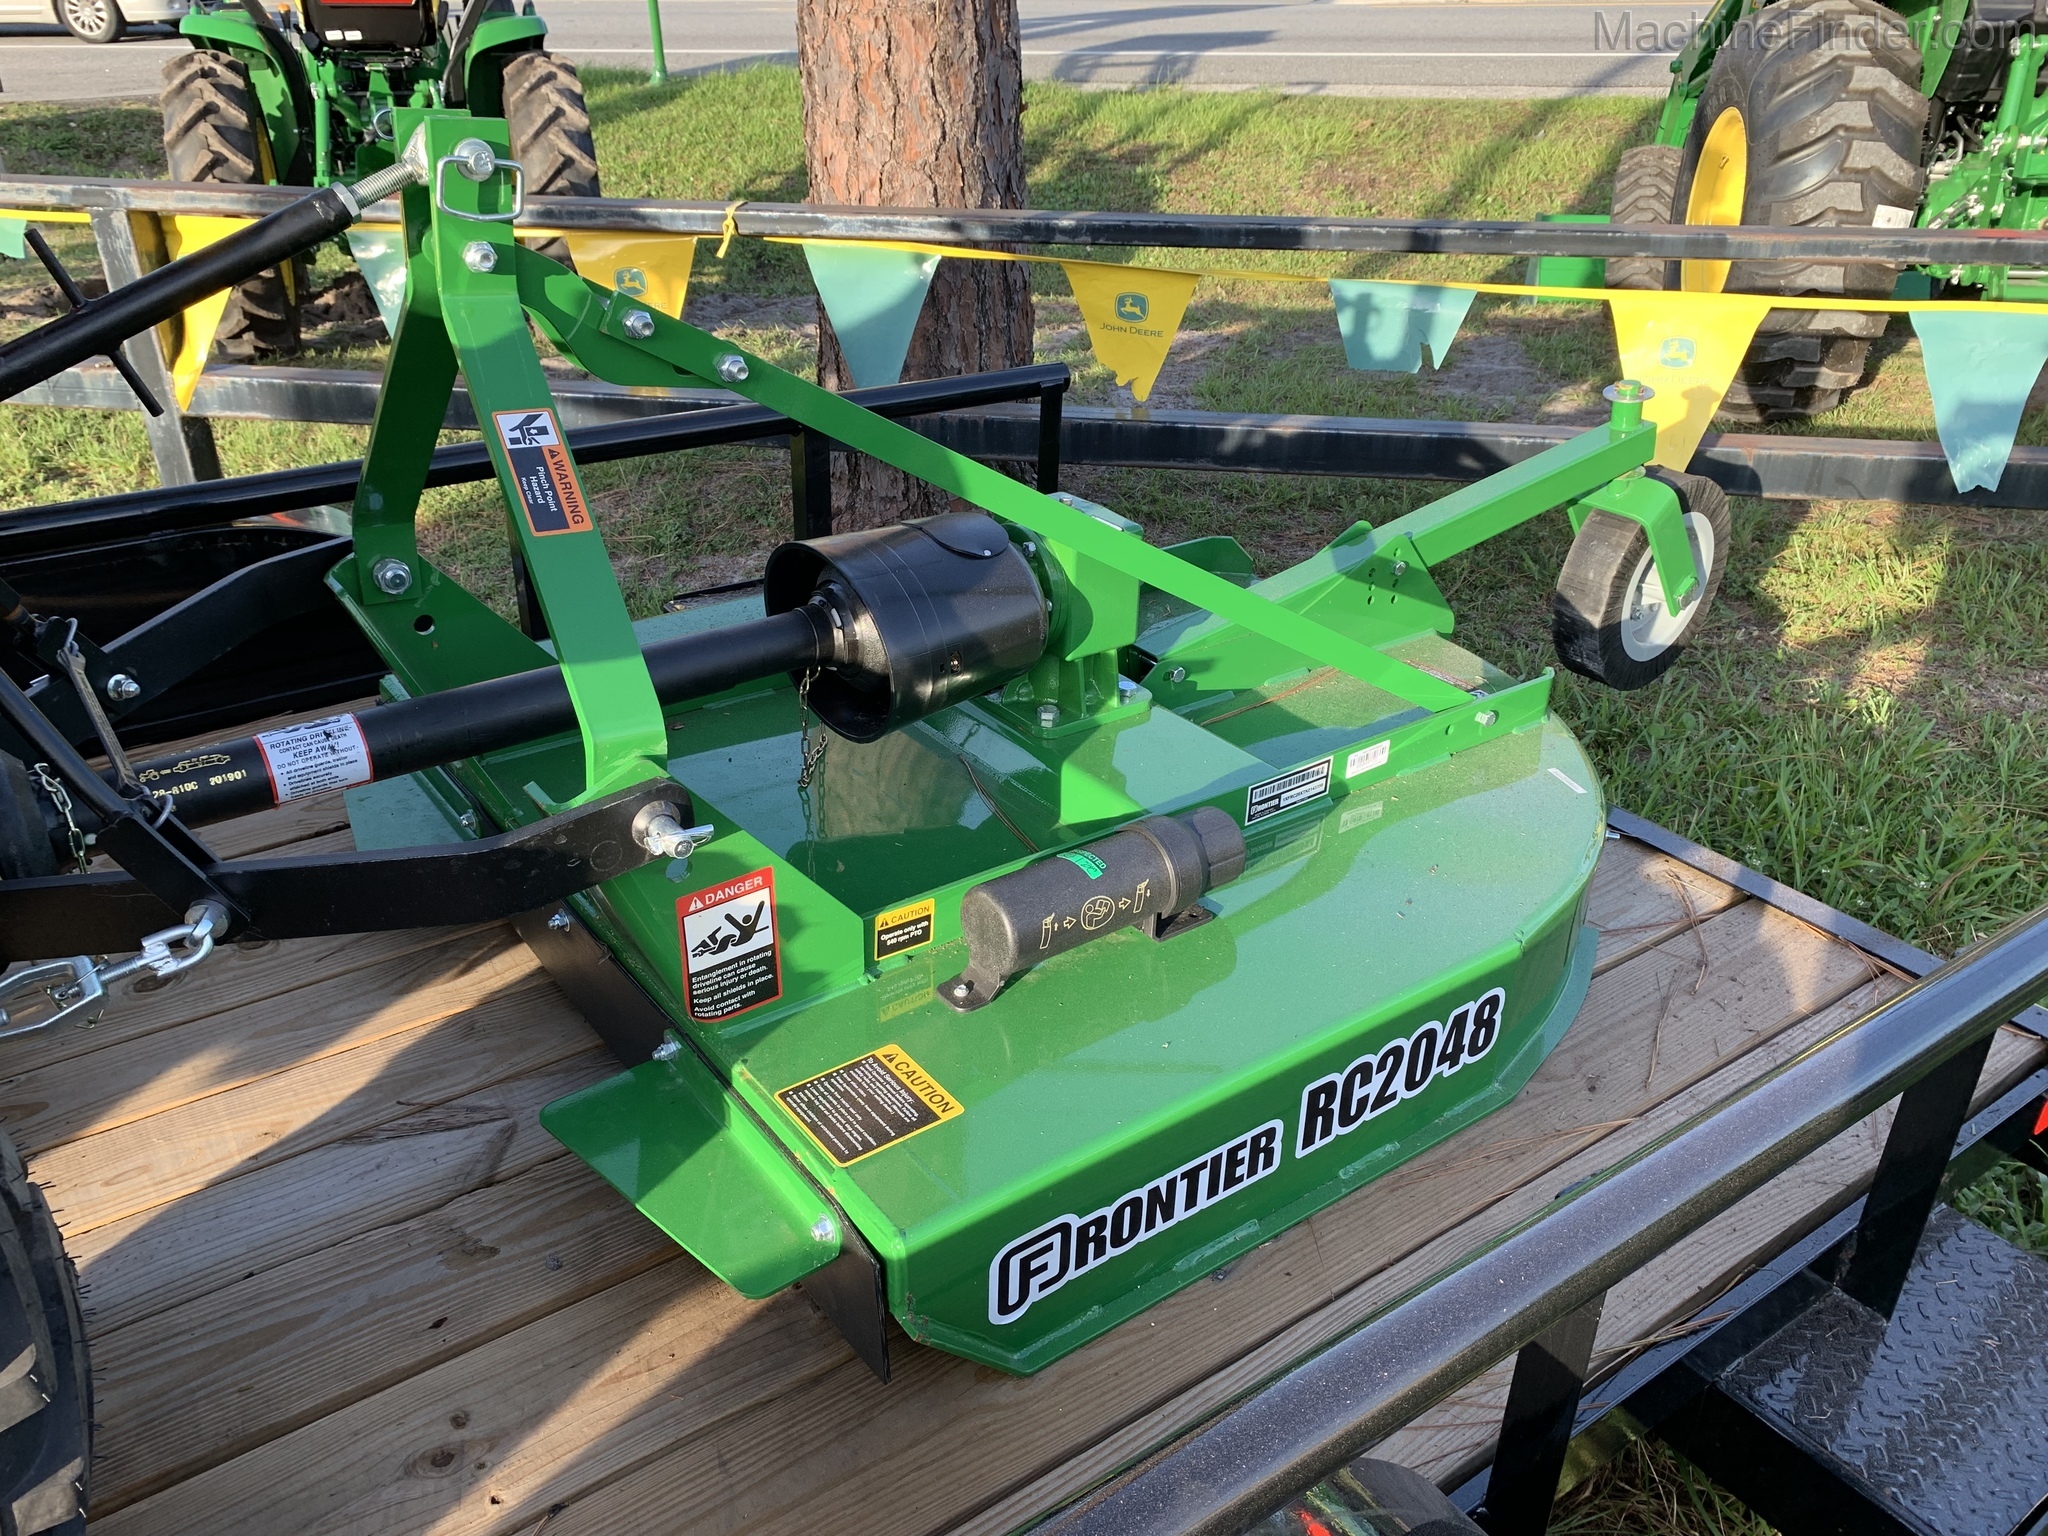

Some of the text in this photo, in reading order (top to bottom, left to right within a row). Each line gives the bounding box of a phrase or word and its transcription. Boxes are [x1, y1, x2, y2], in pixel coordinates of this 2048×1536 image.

[1100, 322, 1164, 337] JOHN DEERE
[530, 476, 545, 504] Hazard
[536, 466, 558, 512] Pinch Point
[552, 460, 584, 524] WARNING
[270, 735, 308, 750] ROTATING
[278, 744, 302, 754] CONTACT
[287, 759, 300, 767] NOT
[301, 751, 329, 764] OPERATE
[293, 748, 313, 759] KEEP
[209, 769, 247, 786] 201901
[705, 876, 763, 905] DANGER
[891, 905, 930, 924] CAUTION
[880, 920, 929, 941] Operate only with
[898, 934, 909, 943] rpm
[910, 929, 922, 938] PTO
[692, 962, 738, 983] Entanglement
[746, 950, 772, 963] rotating
[692, 963, 756, 989] driveline can cause
[692, 965, 767, 995] serious injury or death.
[693, 996, 712, 1004] Keep
[713, 992, 722, 1000] all
[722, 984, 746, 997] shields
[694, 990, 756, 1012] Avoid contact with
[694, 1002, 742, 1018] rotating parts.
[866, 1056, 874, 1064] To
[871, 1063, 887, 1076] Avoid
[883, 1073, 901, 1091] Serious
[895, 1061, 955, 1114] CAUTION
[998, 994, 1501, 1316] FRONTIER RC2048
